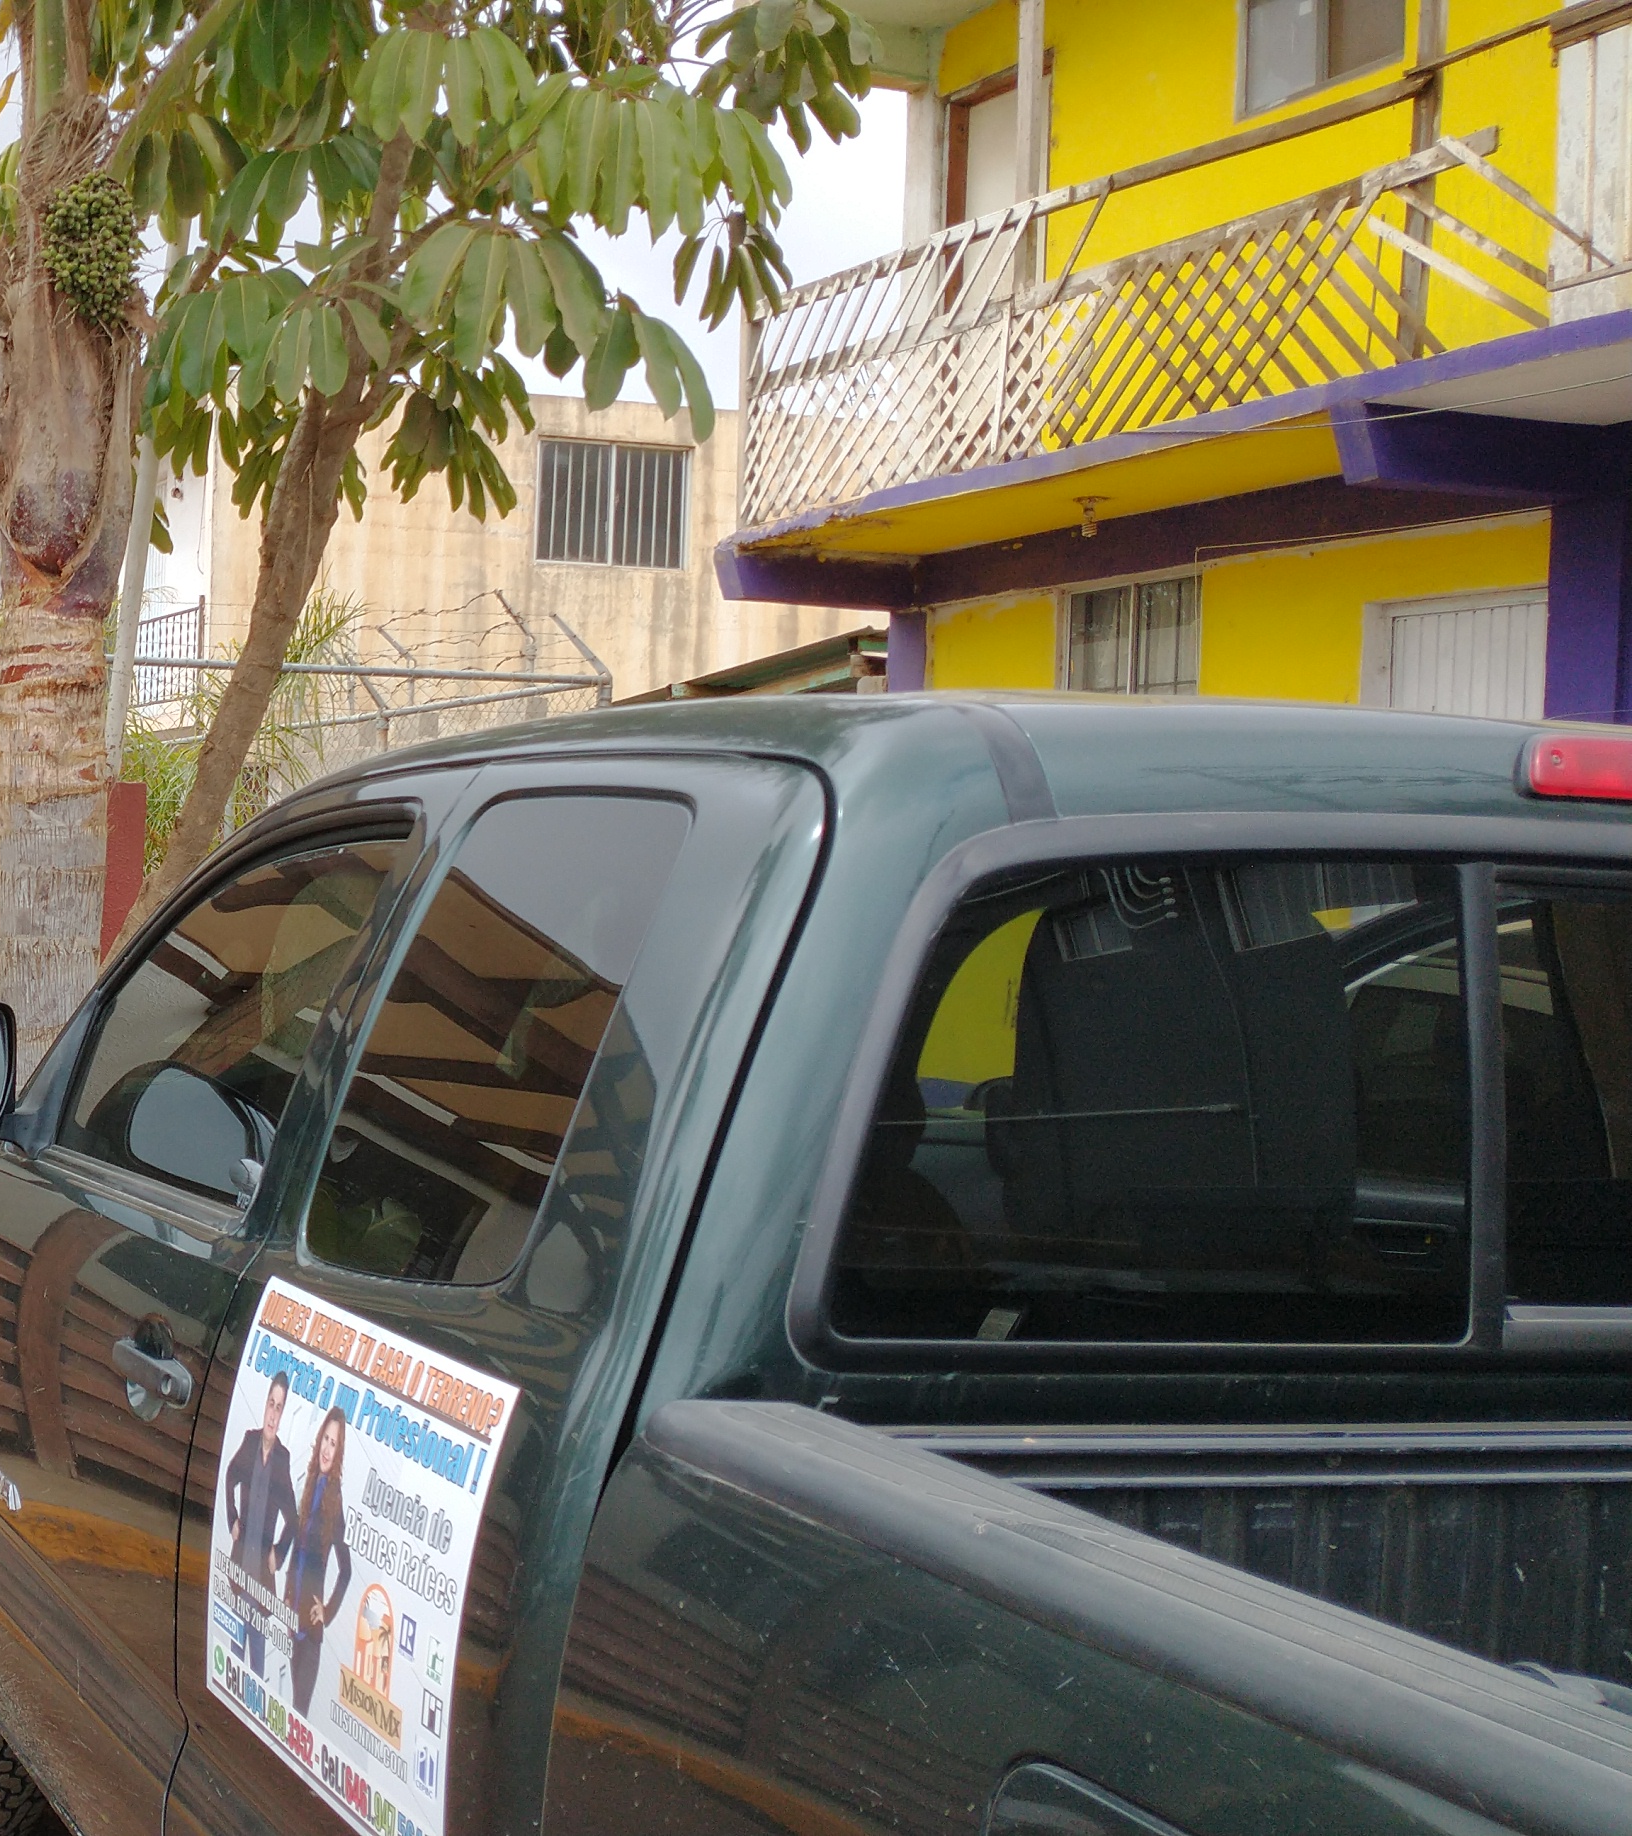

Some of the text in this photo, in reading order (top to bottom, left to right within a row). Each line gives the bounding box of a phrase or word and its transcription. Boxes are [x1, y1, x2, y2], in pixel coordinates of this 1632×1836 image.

[254, 1333, 322, 1403] Contrata
[319, 1375, 335, 1411] a
[333, 1382, 359, 1424] un
[355, 1388, 475, 1487] Profesional
[261, 1290, 505, 1435] QUIERES VENDER TU CASA O TERRENO?
[343, 1505, 457, 1616] Bienes Raíces
[361, 1467, 453, 1555] Agencia de
[214, 1548, 245, 1590] LICENCIA
